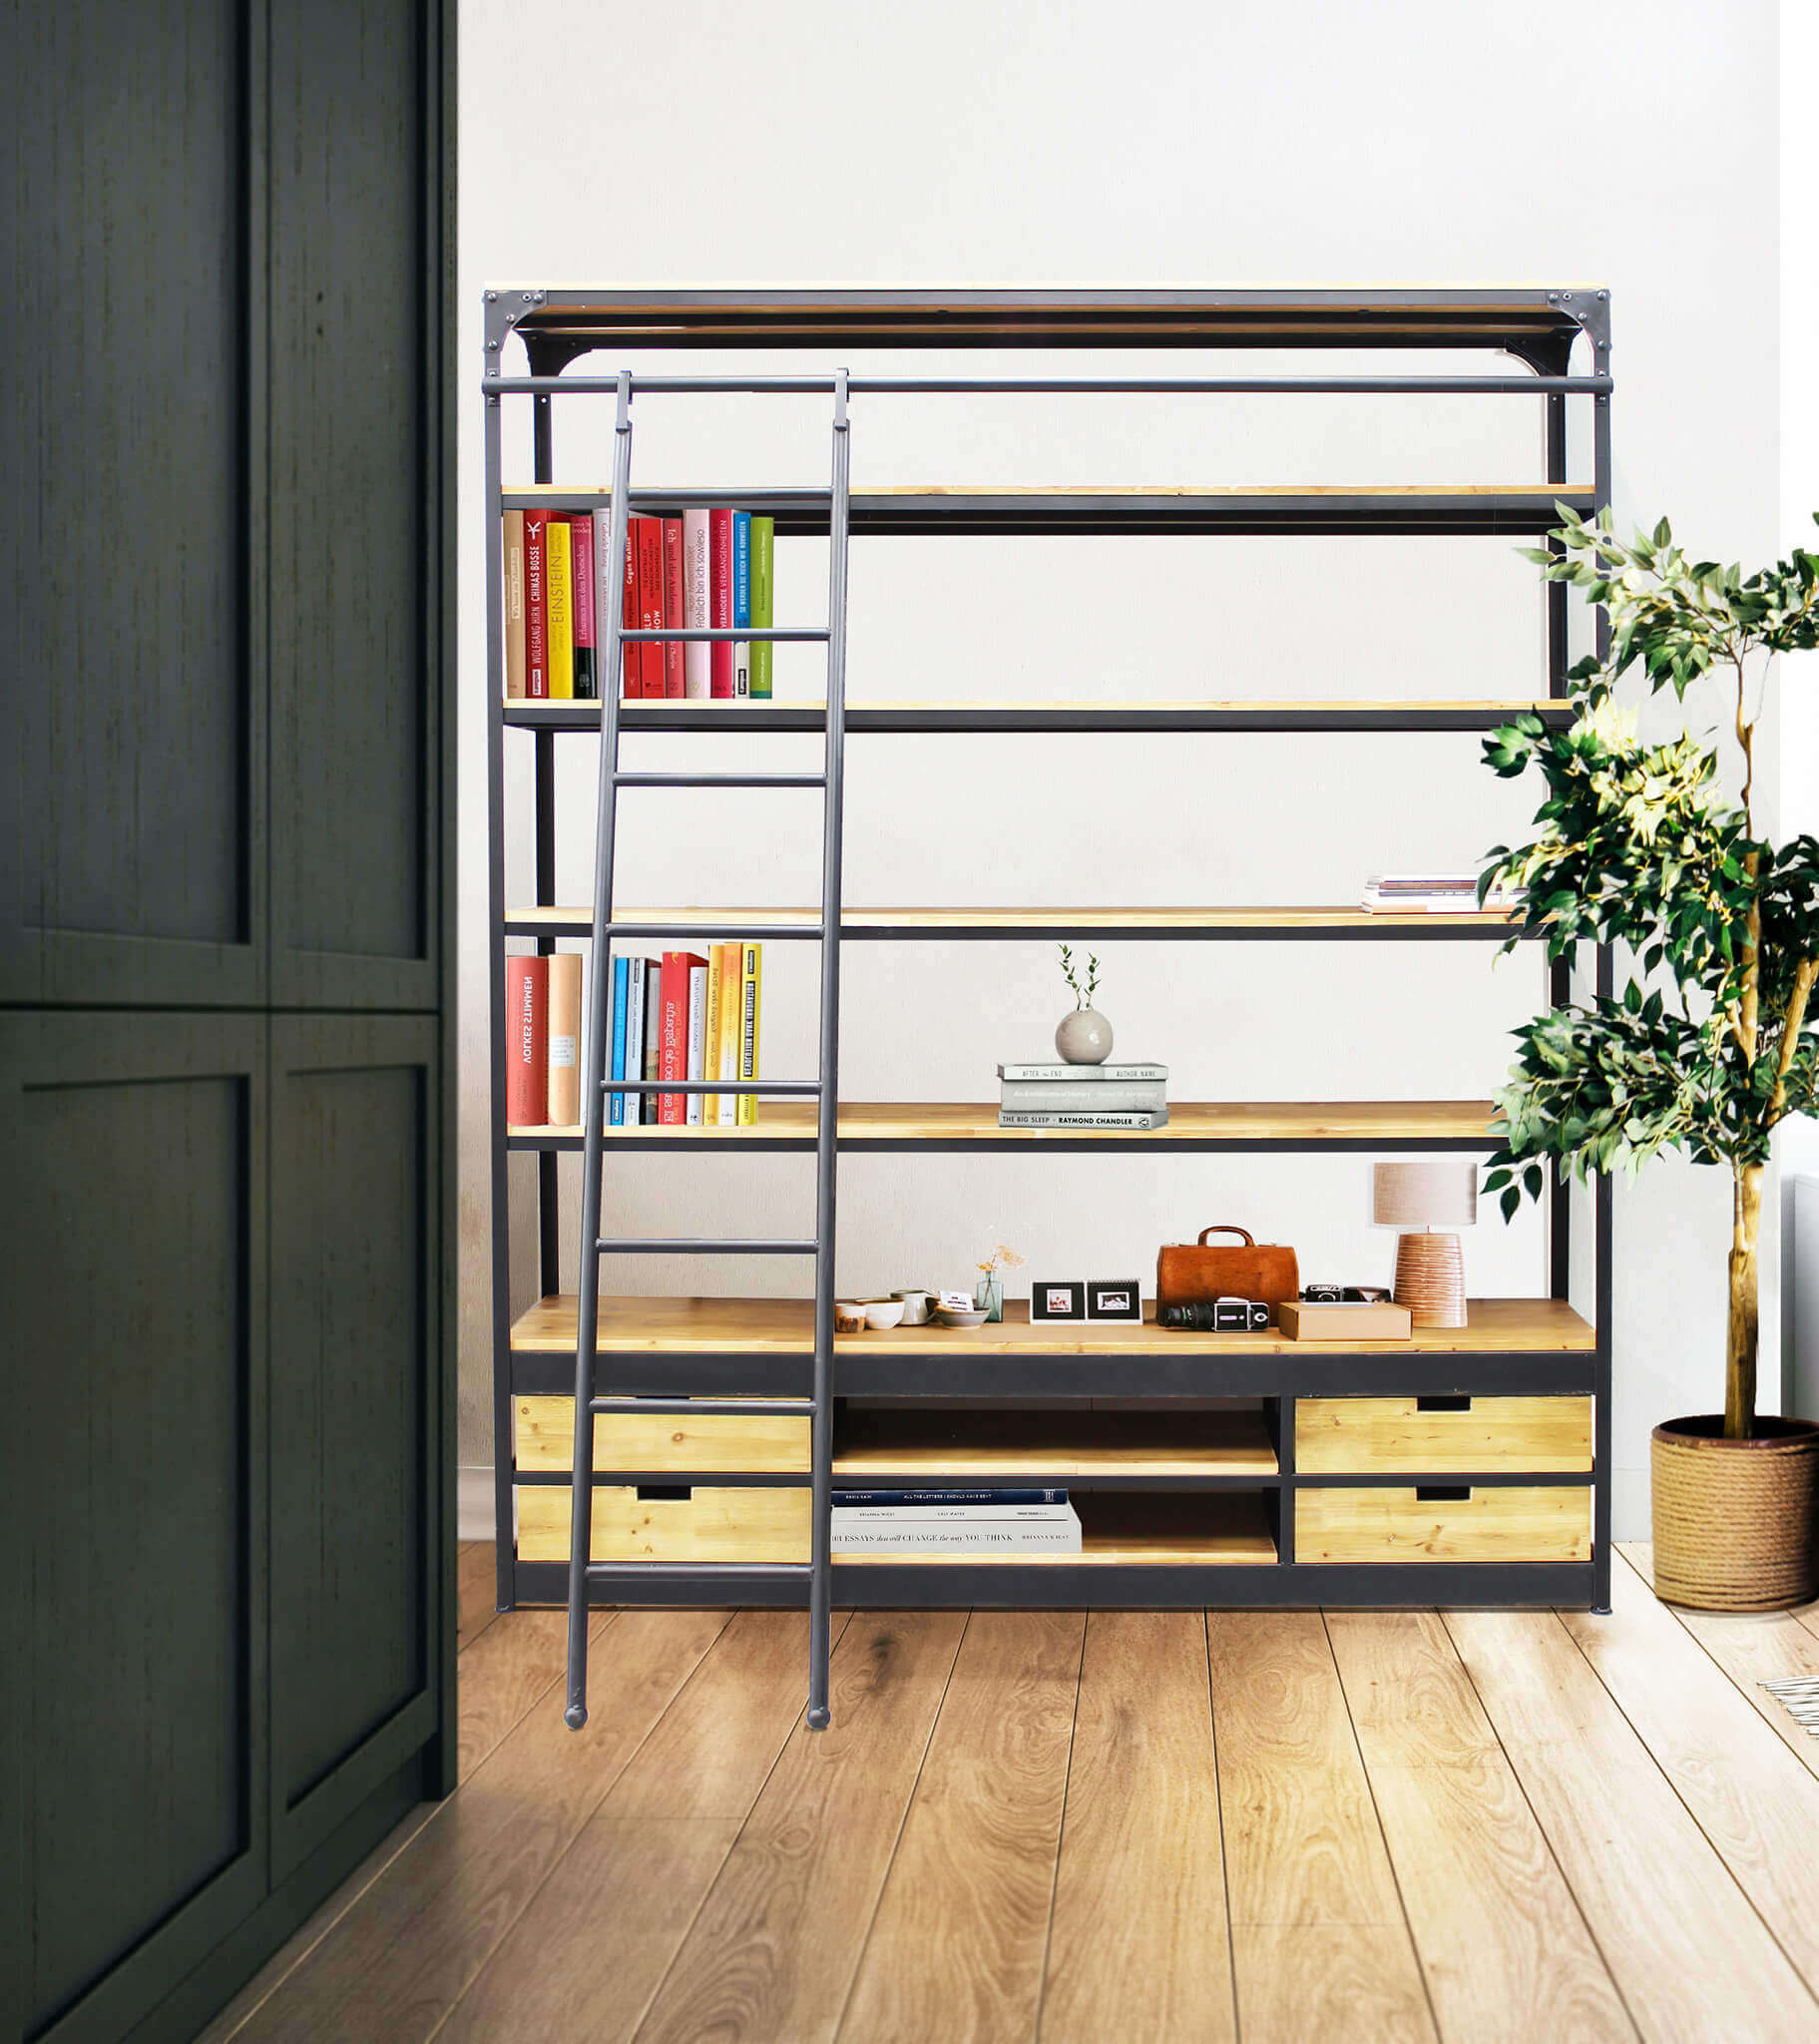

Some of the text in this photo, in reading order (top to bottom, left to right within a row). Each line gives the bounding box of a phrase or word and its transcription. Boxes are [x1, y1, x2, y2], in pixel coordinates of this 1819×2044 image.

[668, 528, 677, 542] Ich
[529, 546, 541, 664] WOLFGANG HIRN CHINAS BOSSE
[550, 556, 564, 623] EINSTEIN
[694, 529, 705, 628] Fröhlich bin ich sowieso
